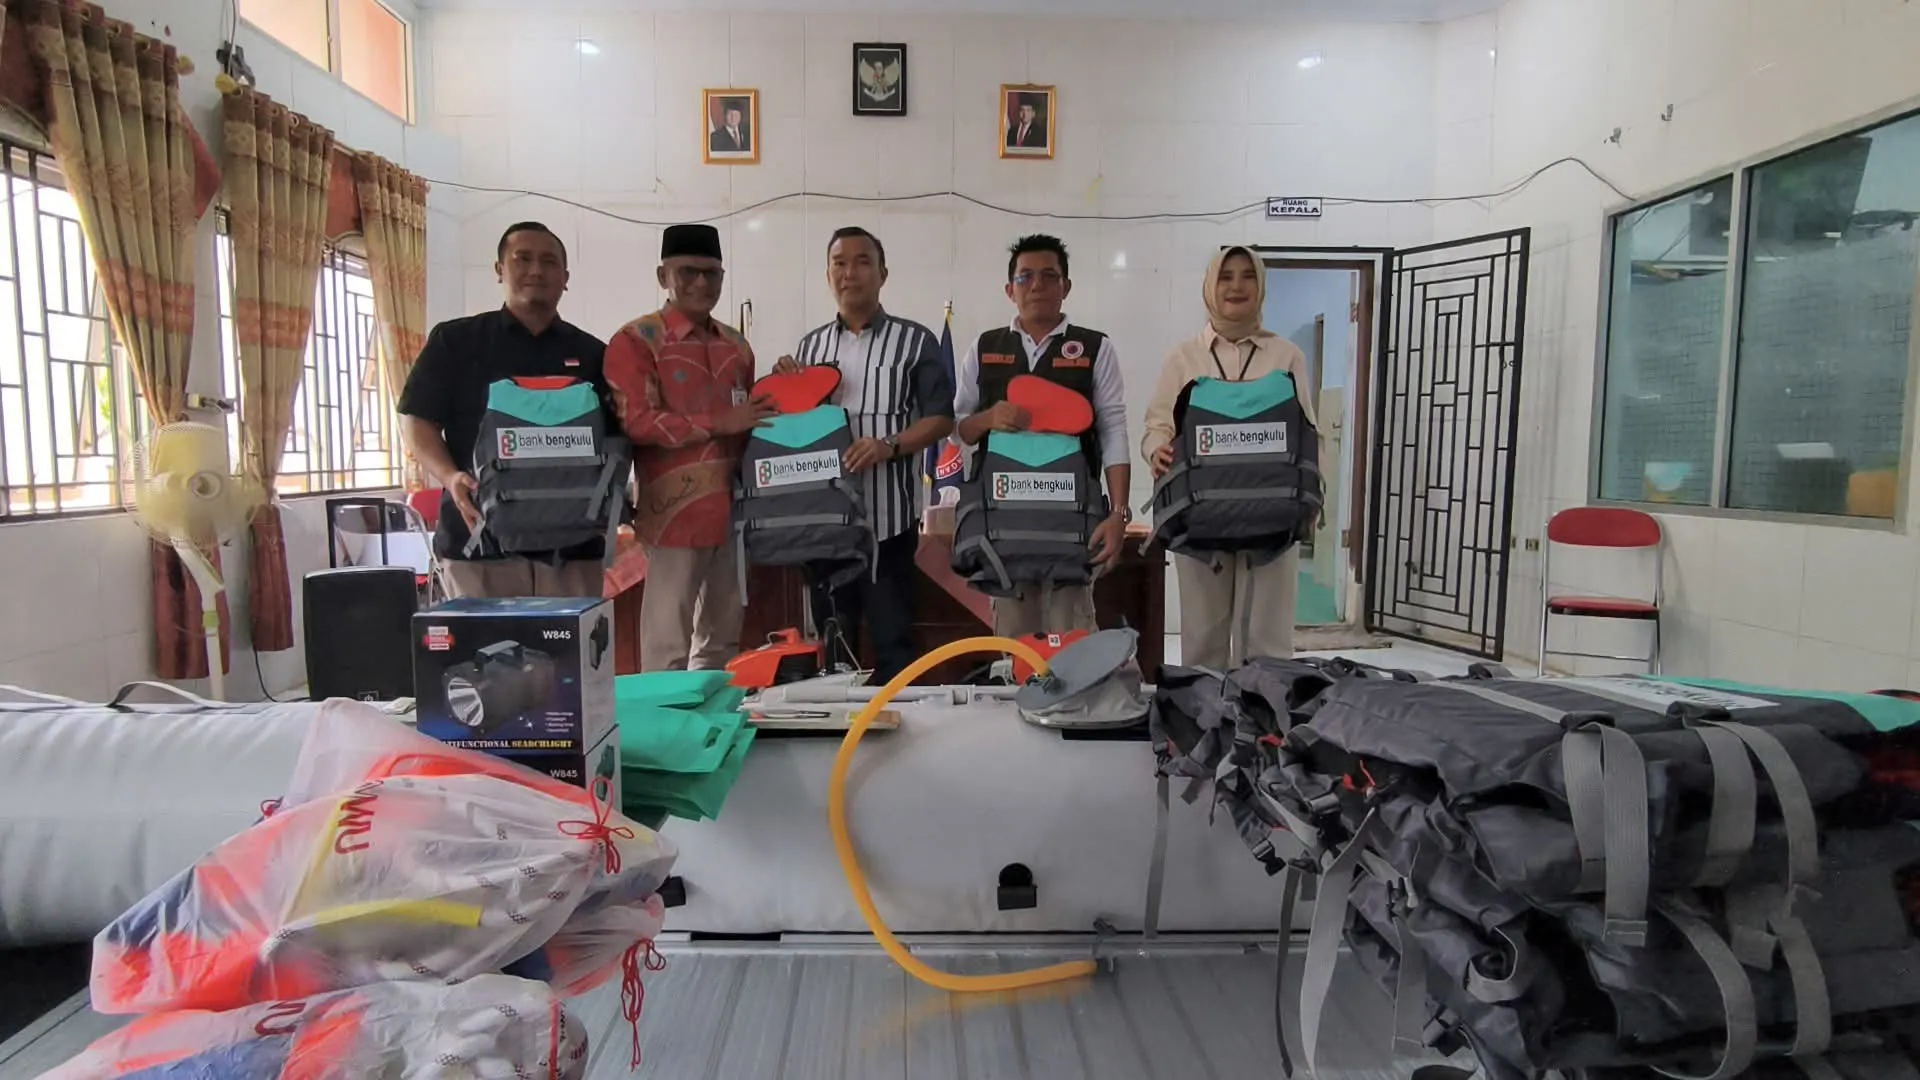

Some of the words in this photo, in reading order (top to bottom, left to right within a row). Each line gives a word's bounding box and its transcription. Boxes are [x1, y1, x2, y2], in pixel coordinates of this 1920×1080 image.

[519, 433, 543, 447] bank
[545, 433, 592, 448] bengkulu
[1215, 430, 1239, 444] bank
[1239, 429, 1285, 444] bengkulu
[773, 461, 796, 475] bank
[796, 456, 838, 472] bengkulu
[1010, 479, 1032, 491] bank
[1033, 479, 1074, 493] bengkulu
[542, 630, 571, 640] W845
[512, 740, 573, 748] SEARCHLIGHT
[550, 769, 578, 778] W845
